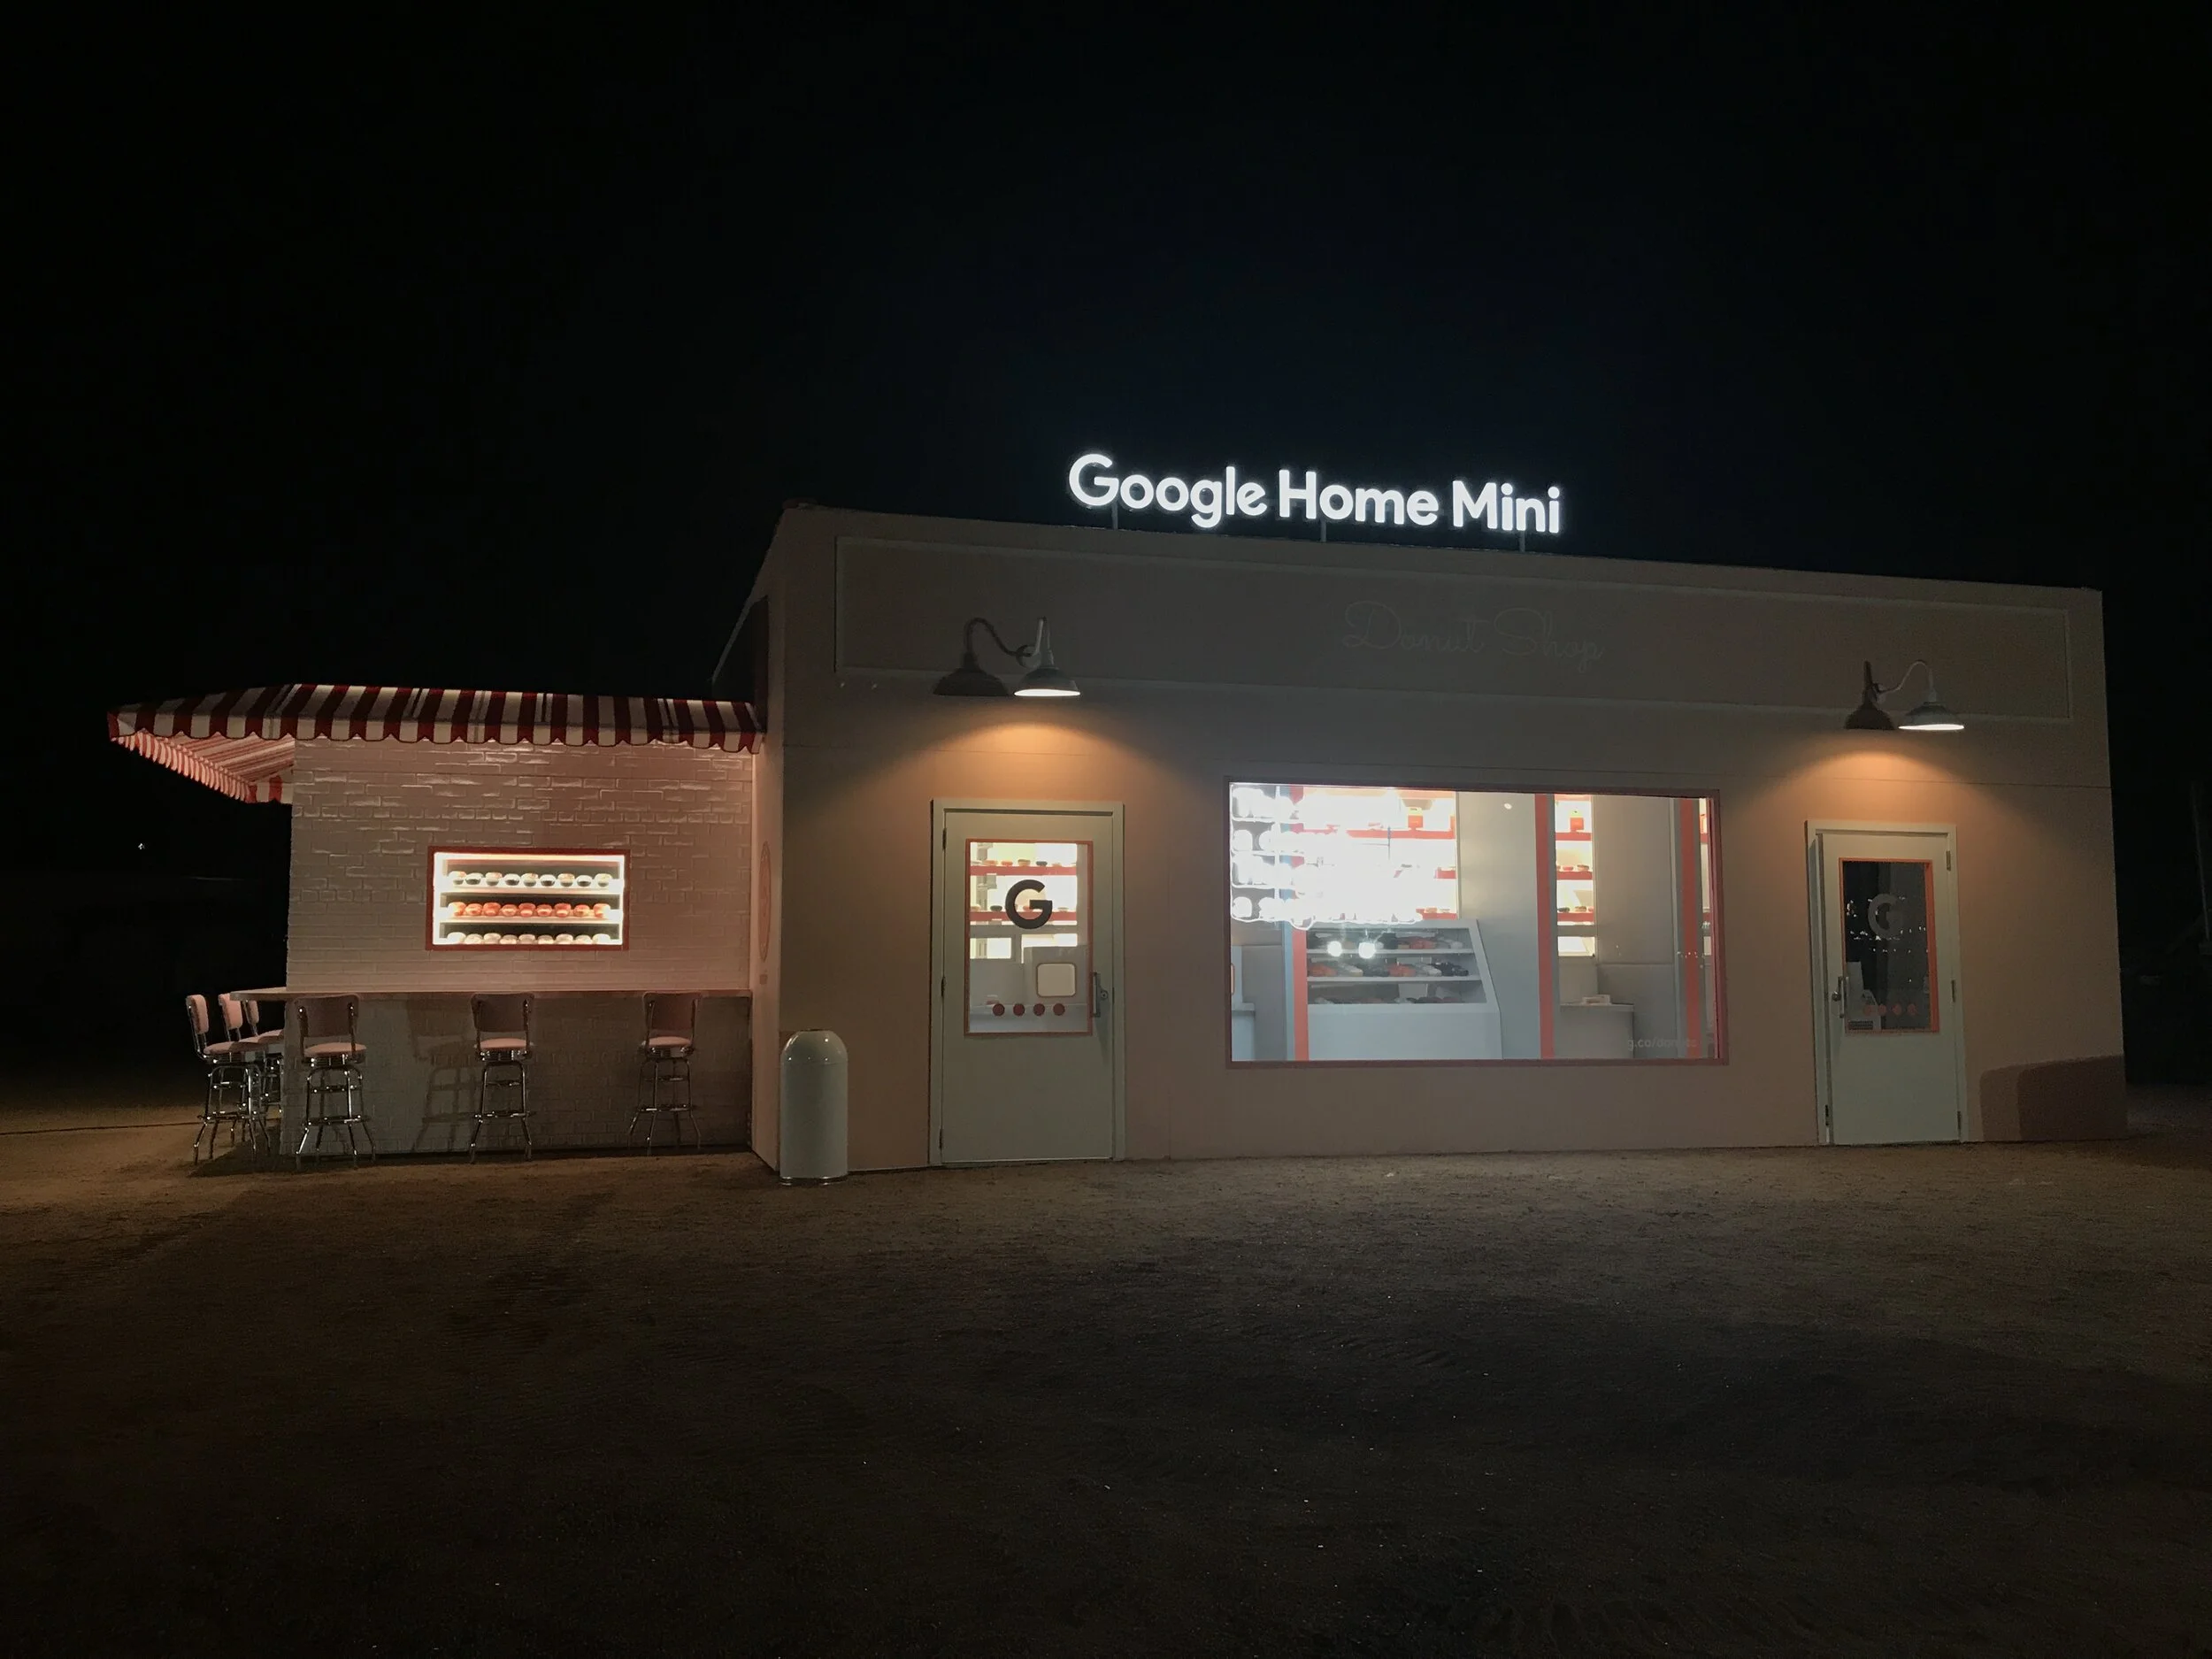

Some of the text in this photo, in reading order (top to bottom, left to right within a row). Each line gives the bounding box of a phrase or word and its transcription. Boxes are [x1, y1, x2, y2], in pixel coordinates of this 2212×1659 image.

[1070, 454, 1559, 533] Google Home Mini
[1341, 600, 1605, 673] Donut Shop
[1005, 879, 1053, 929] G
[1627, 1036, 1698, 1051] g.co/donts
